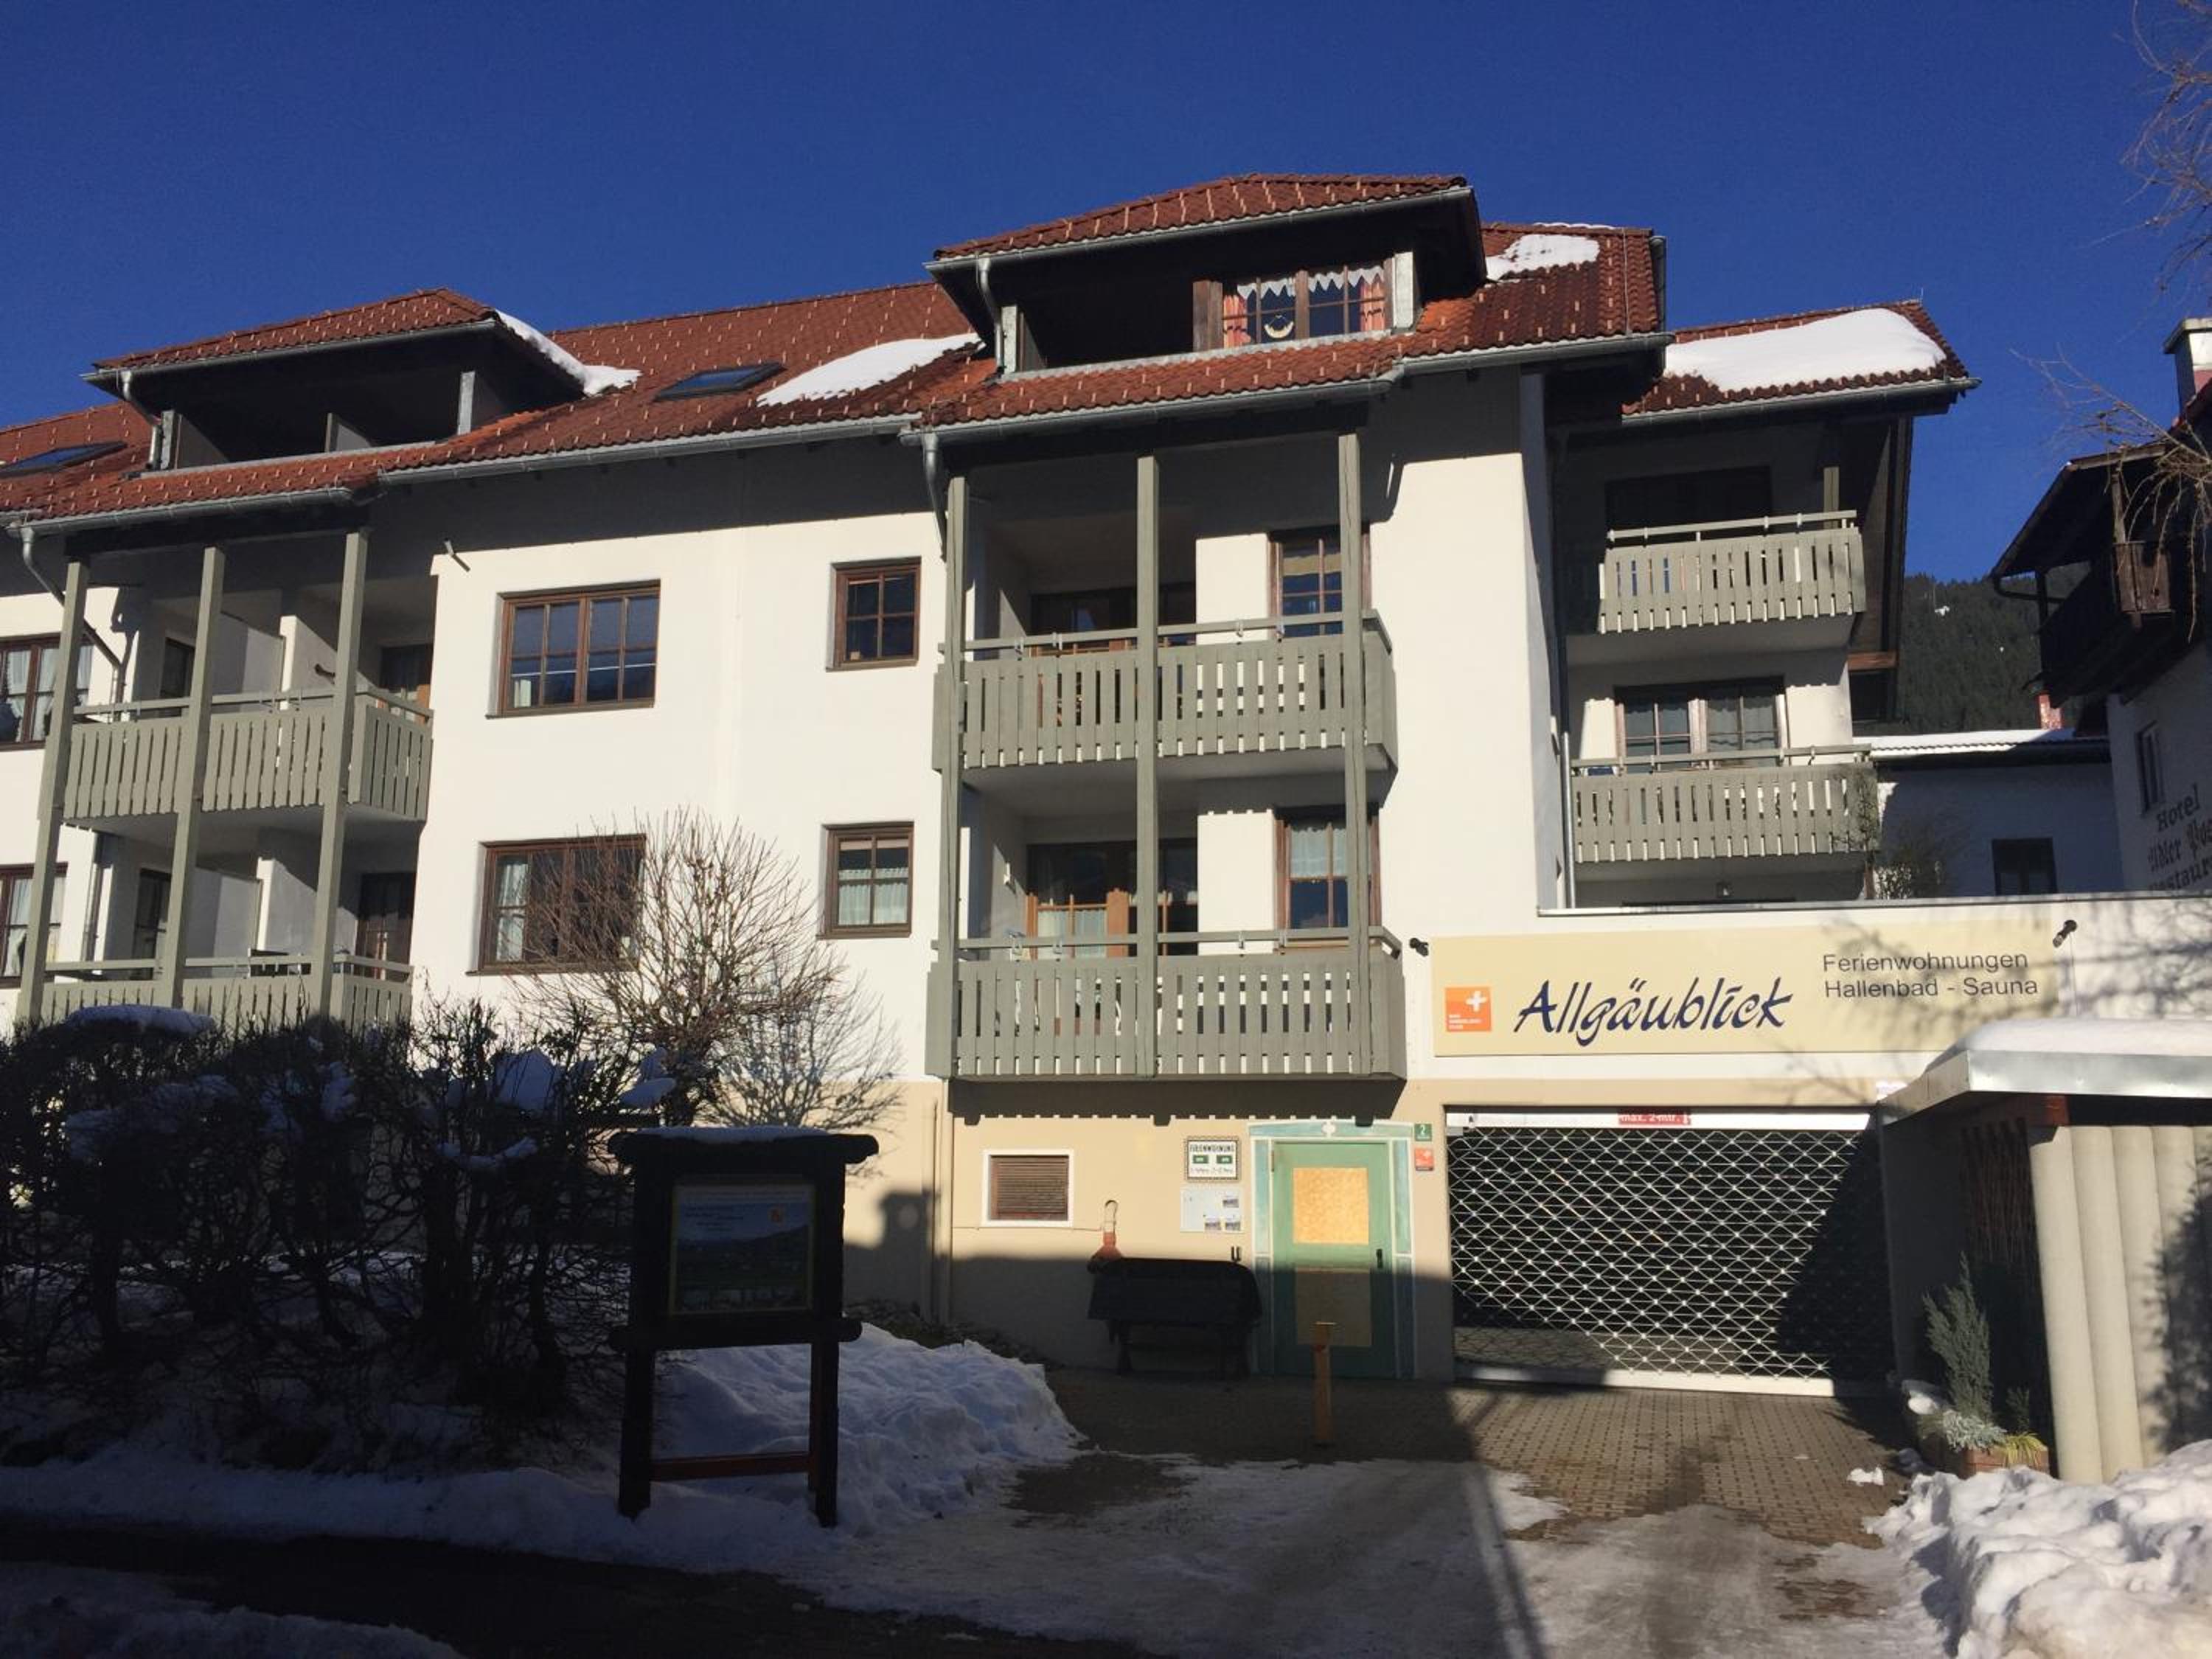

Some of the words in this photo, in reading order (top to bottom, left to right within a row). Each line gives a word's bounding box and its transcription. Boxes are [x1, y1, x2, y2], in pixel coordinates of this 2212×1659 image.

[2157, 782, 2200, 832] Hotel
[1823, 953, 2028, 973] Ferienwohnungen
[1825, 979, 1938, 998] Hallenbad
[1964, 977, 2038, 996] Sauna
[1514, 977, 1792, 1046] Allgäublick
